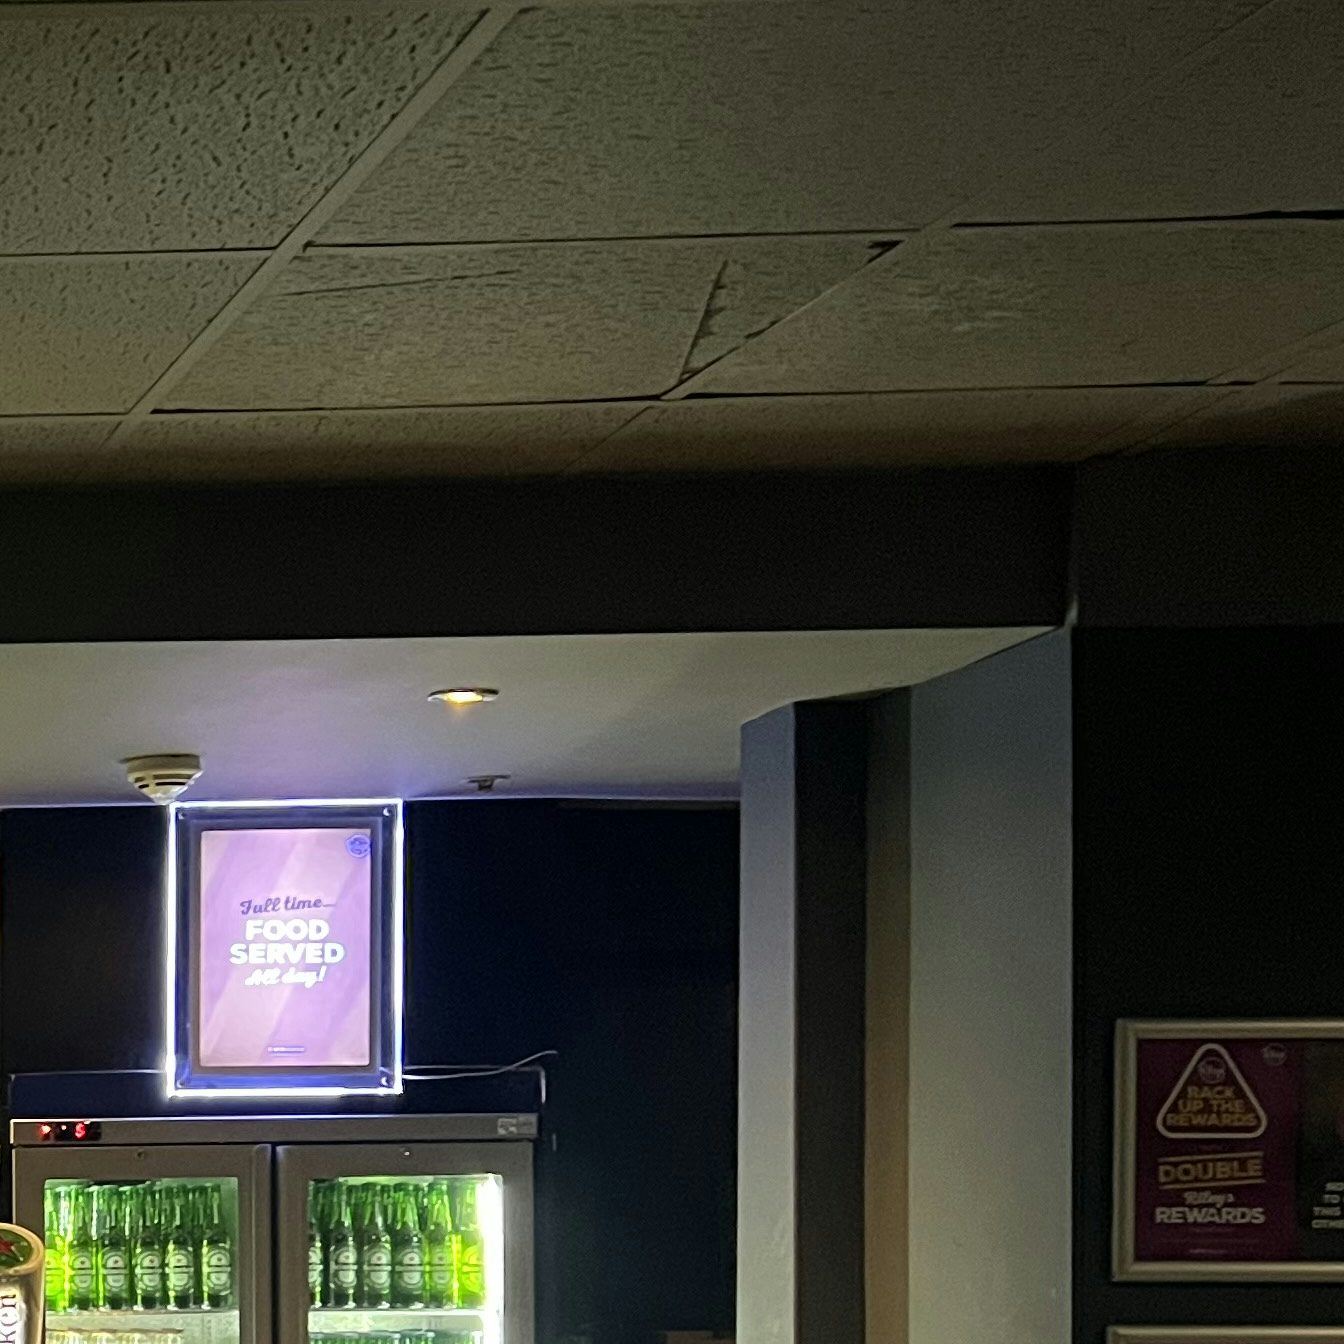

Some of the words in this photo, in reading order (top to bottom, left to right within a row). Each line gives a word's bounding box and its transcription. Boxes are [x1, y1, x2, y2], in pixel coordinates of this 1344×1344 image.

[239, 897, 280, 916] Full
[244, 918, 330, 941] FOOD
[229, 942, 345, 965] SERVED
[1178, 1100, 1204, 1113] UP
[1209, 1100, 1246, 1113] THE
[1166, 1113, 1258, 1127] REWARDS
[1158, 1158, 1263, 1184] DOUBLE
[1155, 1207, 1266, 1224] REWARDS
